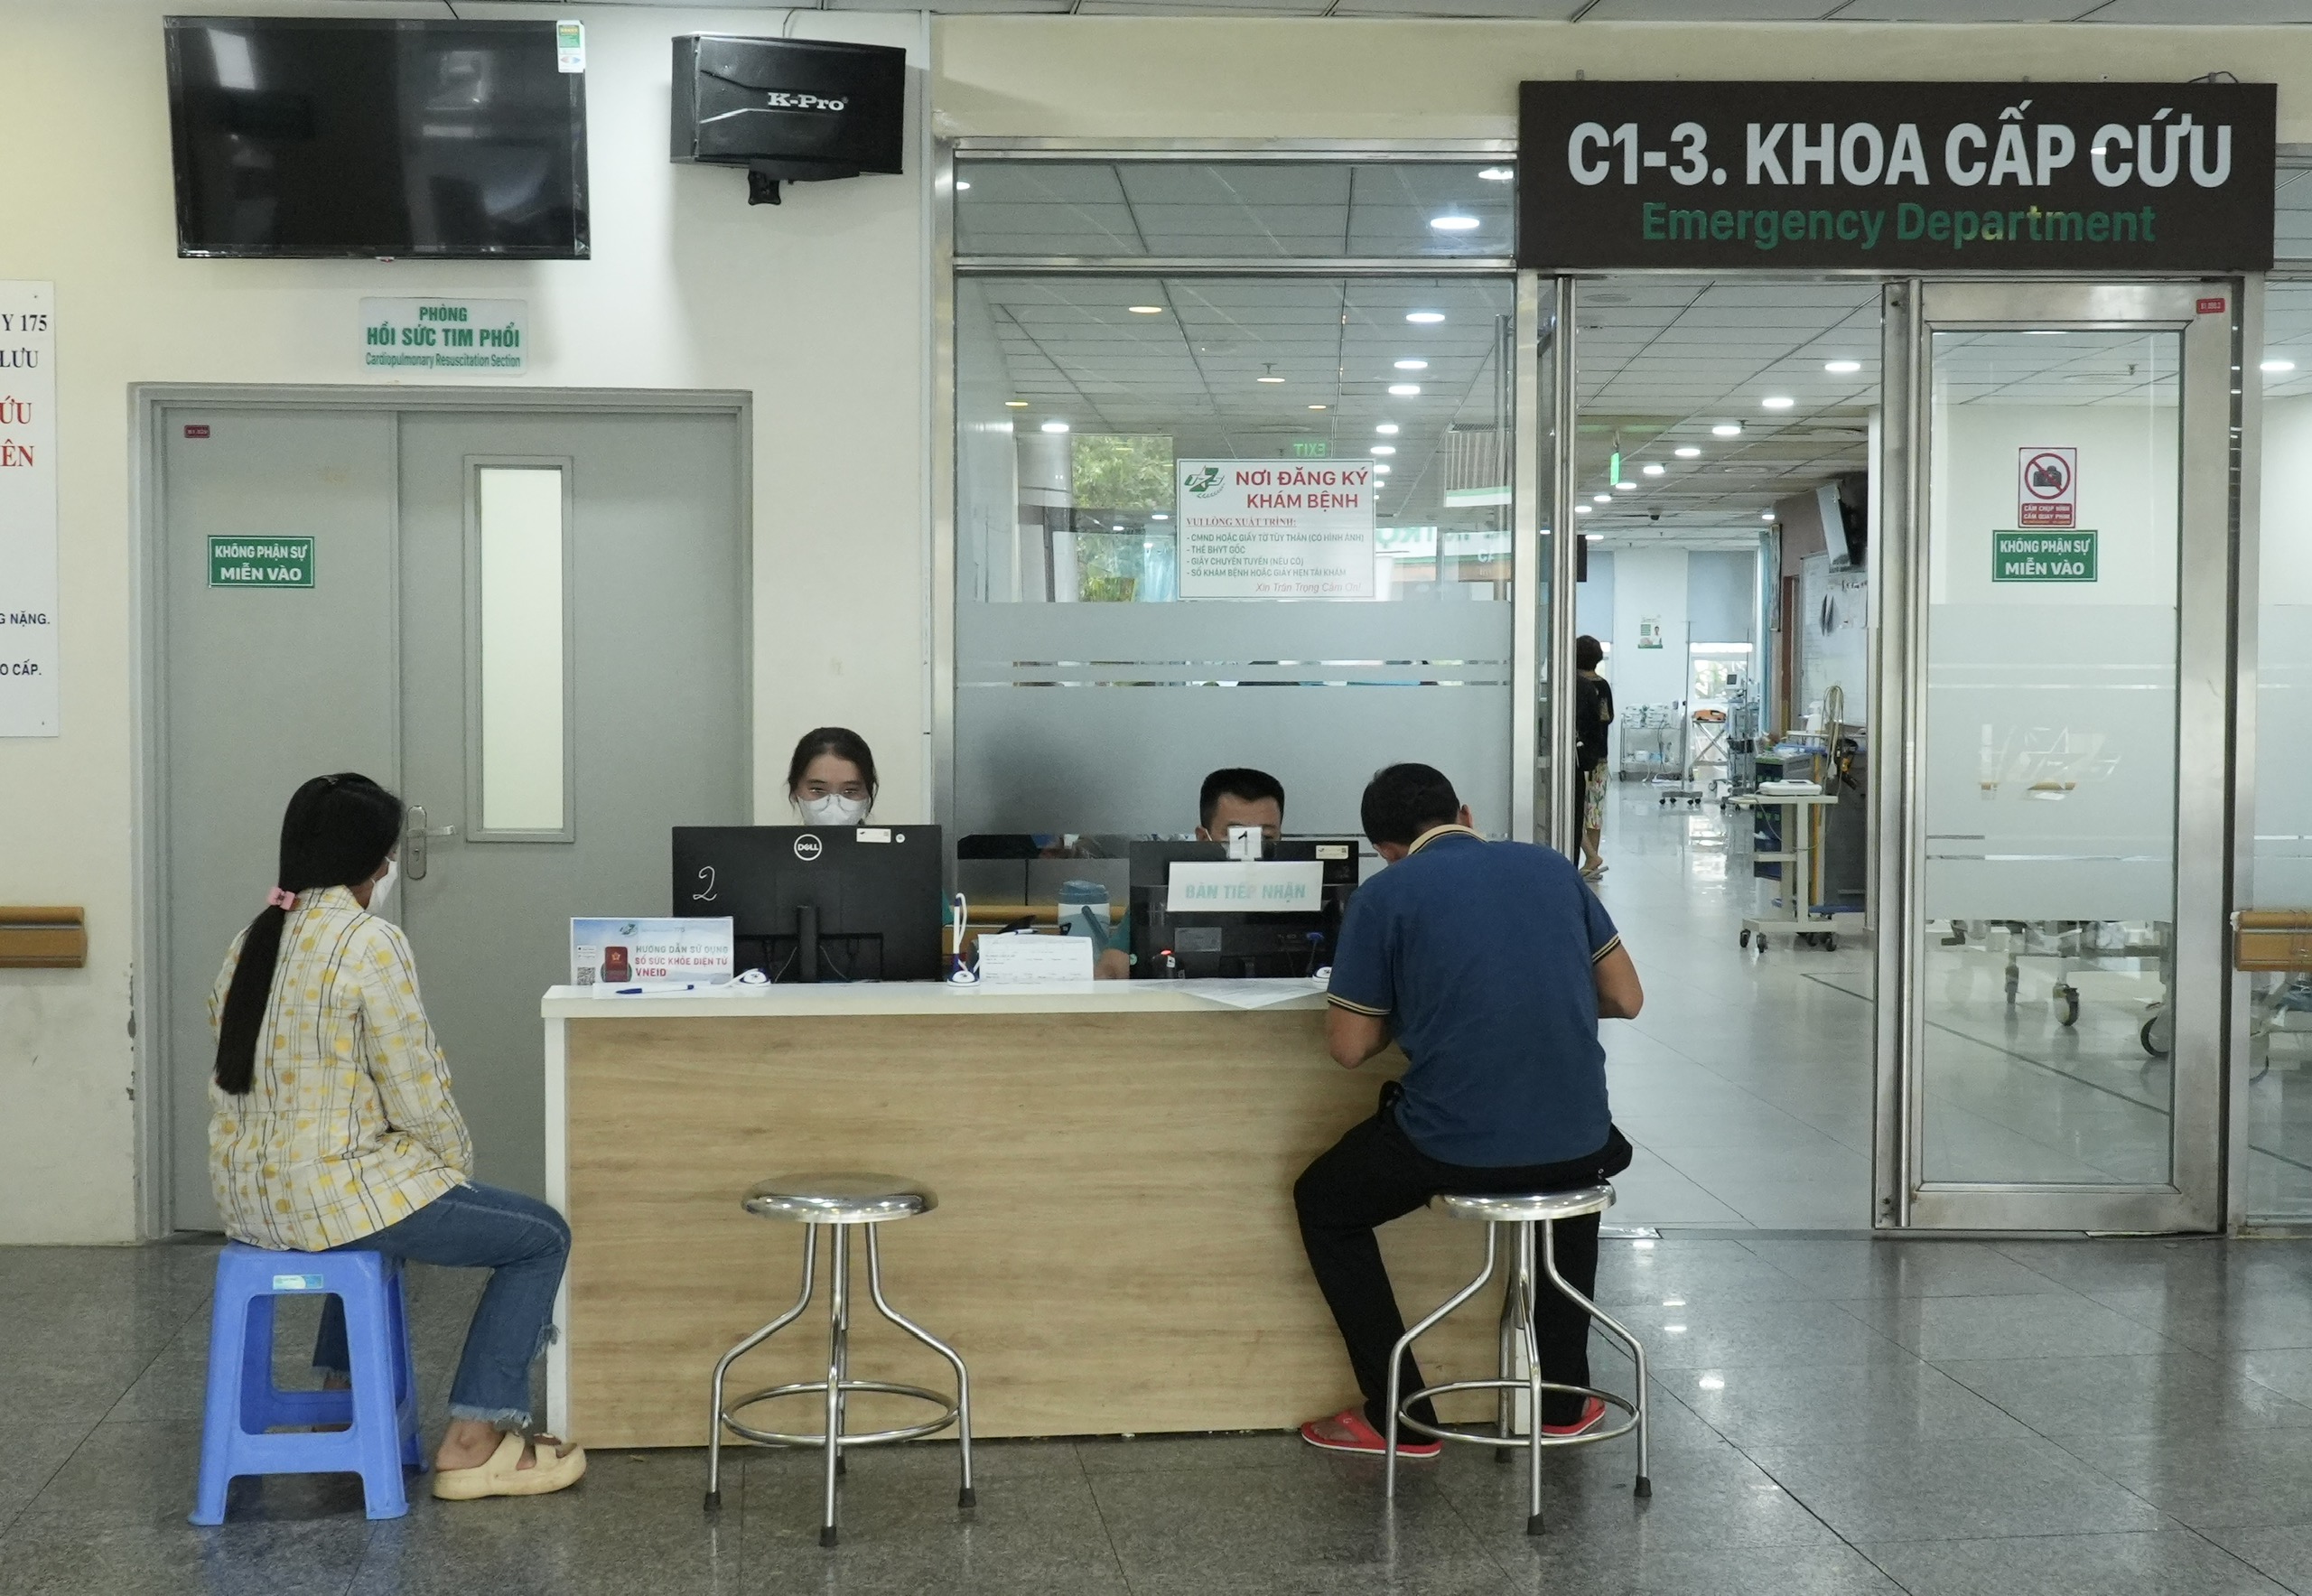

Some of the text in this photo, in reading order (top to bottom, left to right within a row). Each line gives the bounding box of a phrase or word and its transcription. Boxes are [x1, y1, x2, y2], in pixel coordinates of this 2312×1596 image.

[768, 92, 844, 111] K-Pro
[1568, 99, 2233, 188] C1-3. KHOA CẤP CỨU
[1642, 201, 2157, 250] Emergency Department
[419, 303, 468, 322] PHÒNG
[2, 313, 48, 331] Y 175
[367, 321, 520, 348] HỒI SỨC TIM PHỔI
[365, 352, 521, 369] Cardiopulmonary Resuscitation Section
[1235, 469, 1272, 486] NƠI
[1277, 466, 1336, 486] ĐĂNG
[1341, 466, 1369, 486] KÝ
[1247, 490, 1358, 512] KHÁM BỆNH
[1191, 534, 1215, 542] CMND
[2000, 537, 2091, 555] KHÔNG PHẬN SỰ
[215, 543, 308, 561] KHÔNG PHẬN SỰ
[1207, 546, 1227, 554] BHYT
[220, 562, 303, 581] MIỄN VÀO
[2005, 557, 2085, 575] MIỄN VÀO
[10, 610, 51, 627] NẶNG.
[13, 658, 42, 676] CẤP.
[797, 843, 819, 852] DELL
[1237, 830, 1249, 856] 1
[692, 865, 718, 901] 2
[1185, 882, 1218, 900] BÀN
[1262, 882, 1306, 903] NHẬN
[635, 967, 667, 976] VNEID
